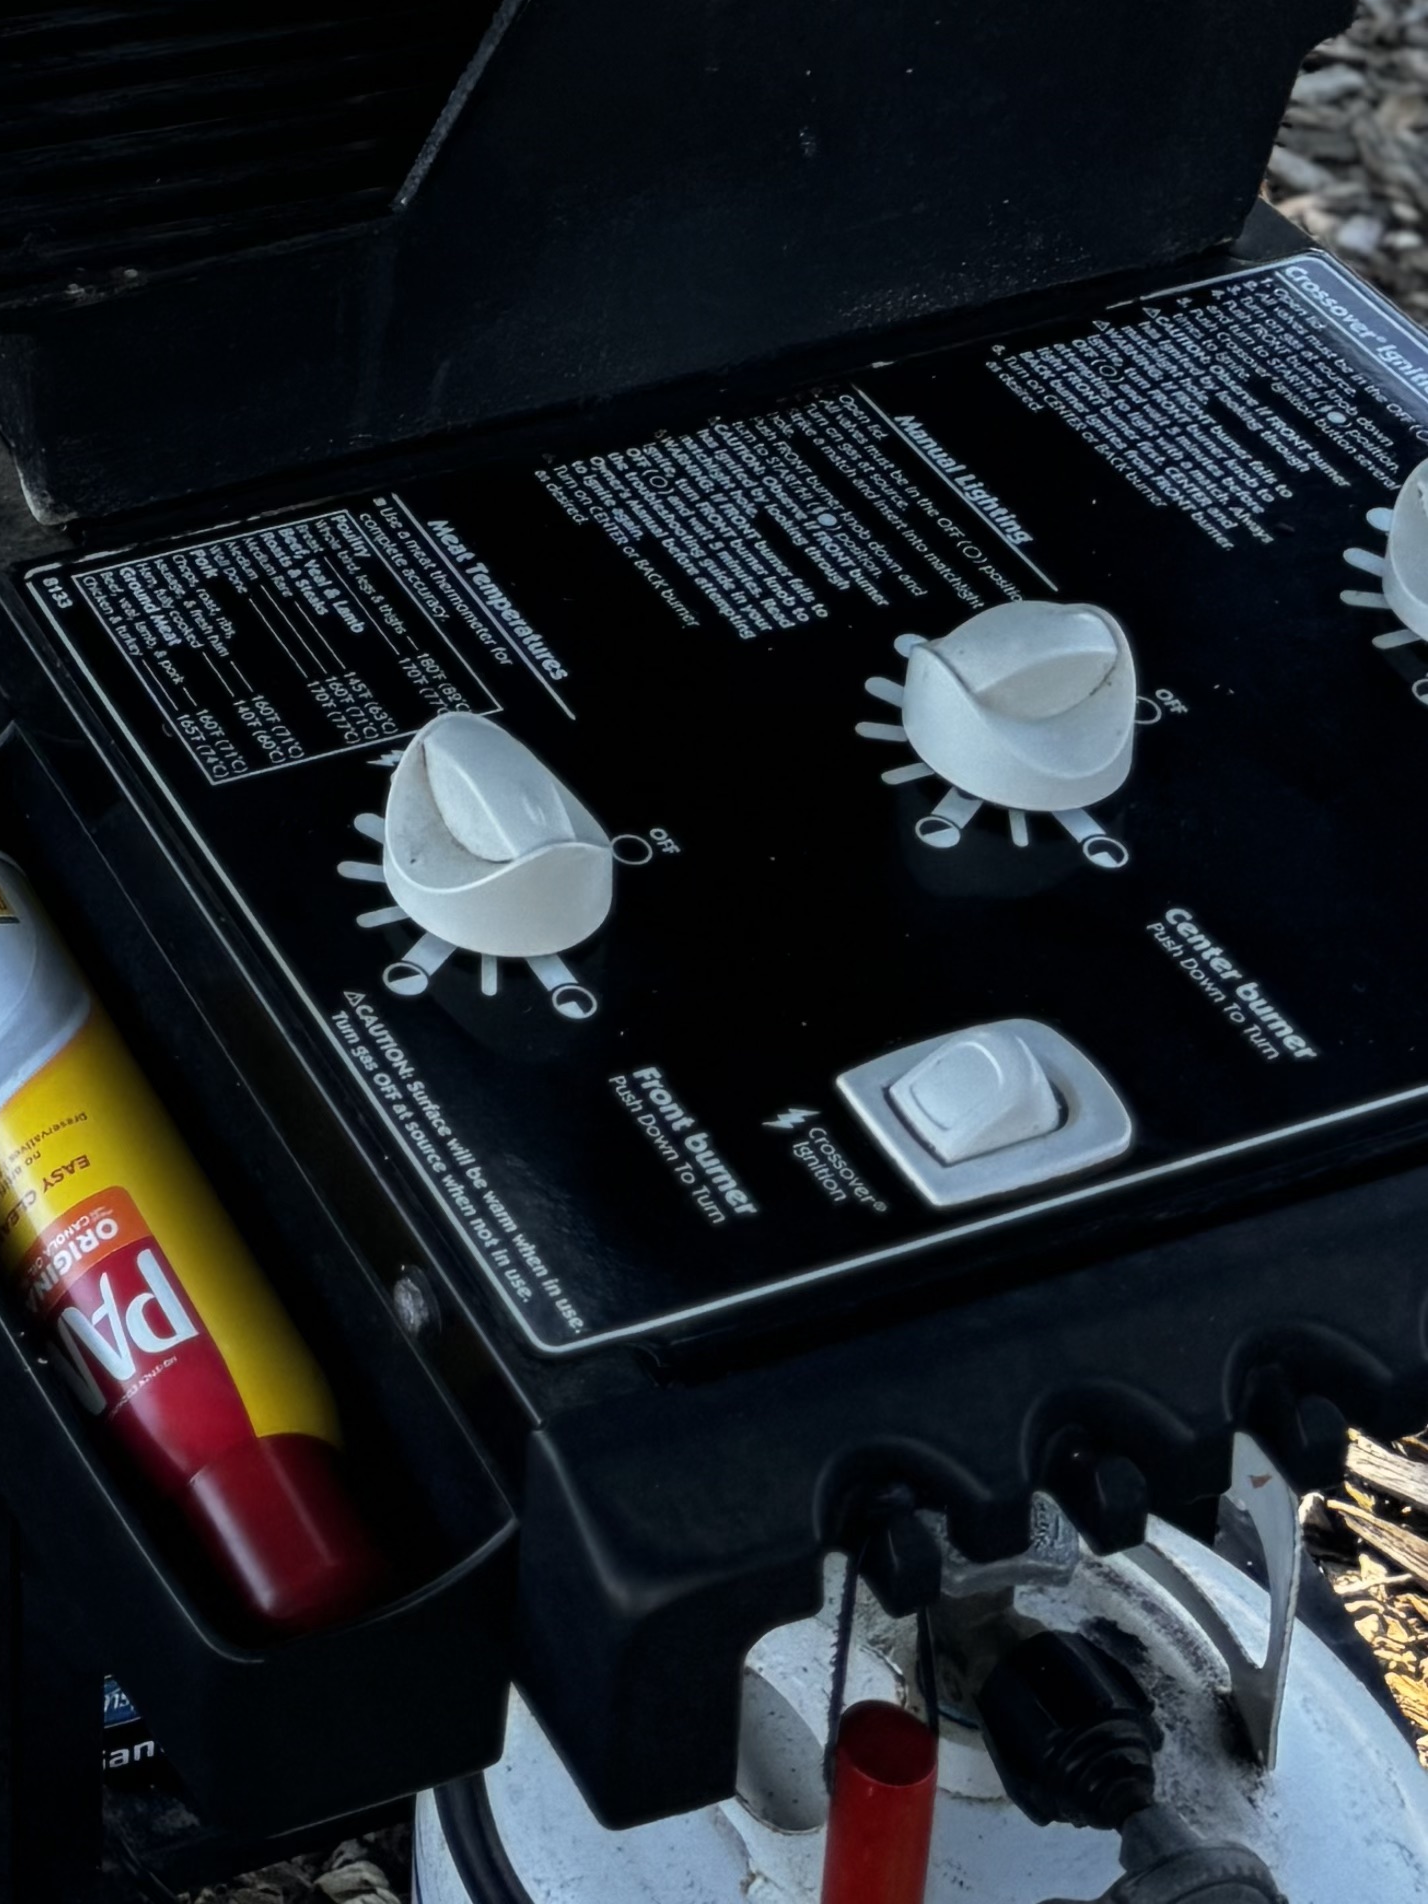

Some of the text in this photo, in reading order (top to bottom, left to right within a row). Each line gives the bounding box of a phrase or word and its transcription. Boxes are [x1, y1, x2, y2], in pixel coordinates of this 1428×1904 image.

[838, 394, 870, 424] Open
[1138, 320, 1310, 472] has ignited by looking through
[1377, 344, 1428, 395] Igniti
[893, 415, 1033, 545] Manual Lighting
[1018, 351, 1234, 550] BACK burner ignites from FRONT burner.
[1036, 346, 1068, 371] light
[1062, 371, 1106, 405] FRONT
[1099, 405, 1140, 440] burner
[1164, 466, 1213, 507] CENTER
[1206, 507, 1238, 529] and
[189, 548, 218, 579] Pork
[330, 514, 371, 557] Poultry
[607, 452, 772, 631] the troubleshooting guide in your
[713, 424, 889, 605] CAUTION: Observe if FRONT burner
[42, 577, 73, 608] 8133
[119, 566, 182, 646] Ground Meat
[259, 531, 328, 615] Roasts & Steaks
[277, 527, 365, 633] Beef, Veal & Lamb
[359, 513, 450, 622] complete accuracy.
[379, 507, 513, 664] Use a meat thermometer for
[426, 520, 568, 680] Meat Temperatures
[437, 683, 470, 713] (82°C
[1154, 688, 1188, 713] OFF
[649, 827, 680, 853] OFF
[1146, 922, 1279, 1060] Push Down To Turn
[1165, 908, 1317, 1058] Center burner
[24, 1150, 41, 1166] no
[42, 1153, 91, 1193] EASY
[331, 1010, 532, 1303] Turn gas OFF at source when not in use.
[352, 1004, 584, 1334] CAUTION: Surface will be warm when in use.
[608, 1075, 725, 1224] Push Down To Turn
[632, 1066, 757, 1213] Front burner
[792, 1140, 846, 1201] Ignition
[808, 1127, 886, 1212] Crossover®
[23, 1218, 118, 1313] ORIGINA
[42, 1214, 91, 1257] CANOLA
